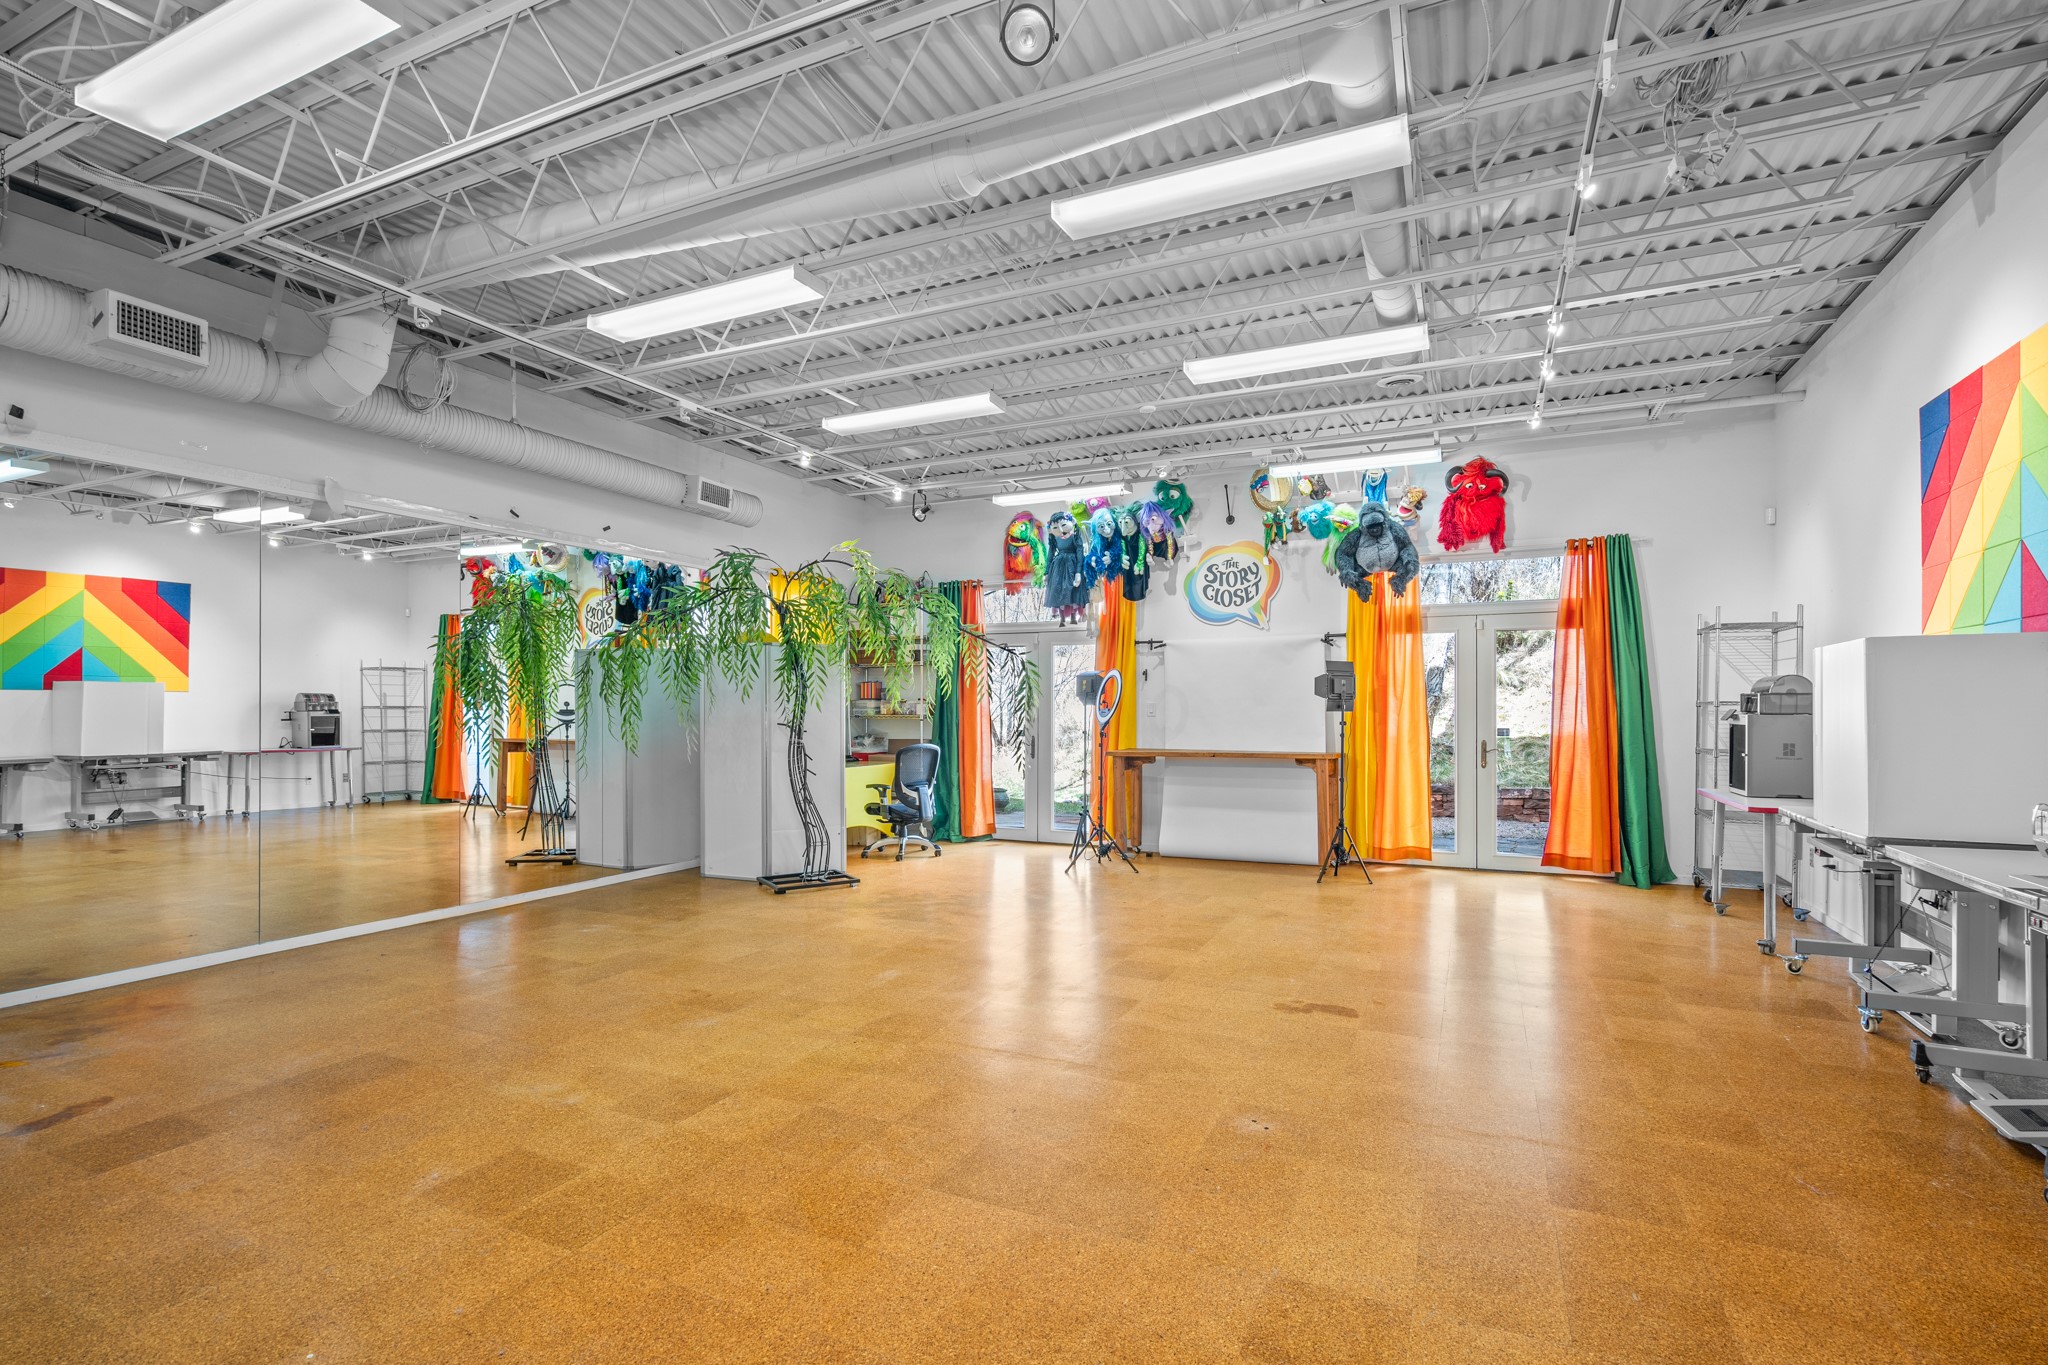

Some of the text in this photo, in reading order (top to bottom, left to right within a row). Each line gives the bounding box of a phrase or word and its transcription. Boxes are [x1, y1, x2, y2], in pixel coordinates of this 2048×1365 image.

[1204, 562, 1260, 588] STORY
[1222, 557, 1240, 570] THE
[1202, 576, 1262, 607] CLOSET
